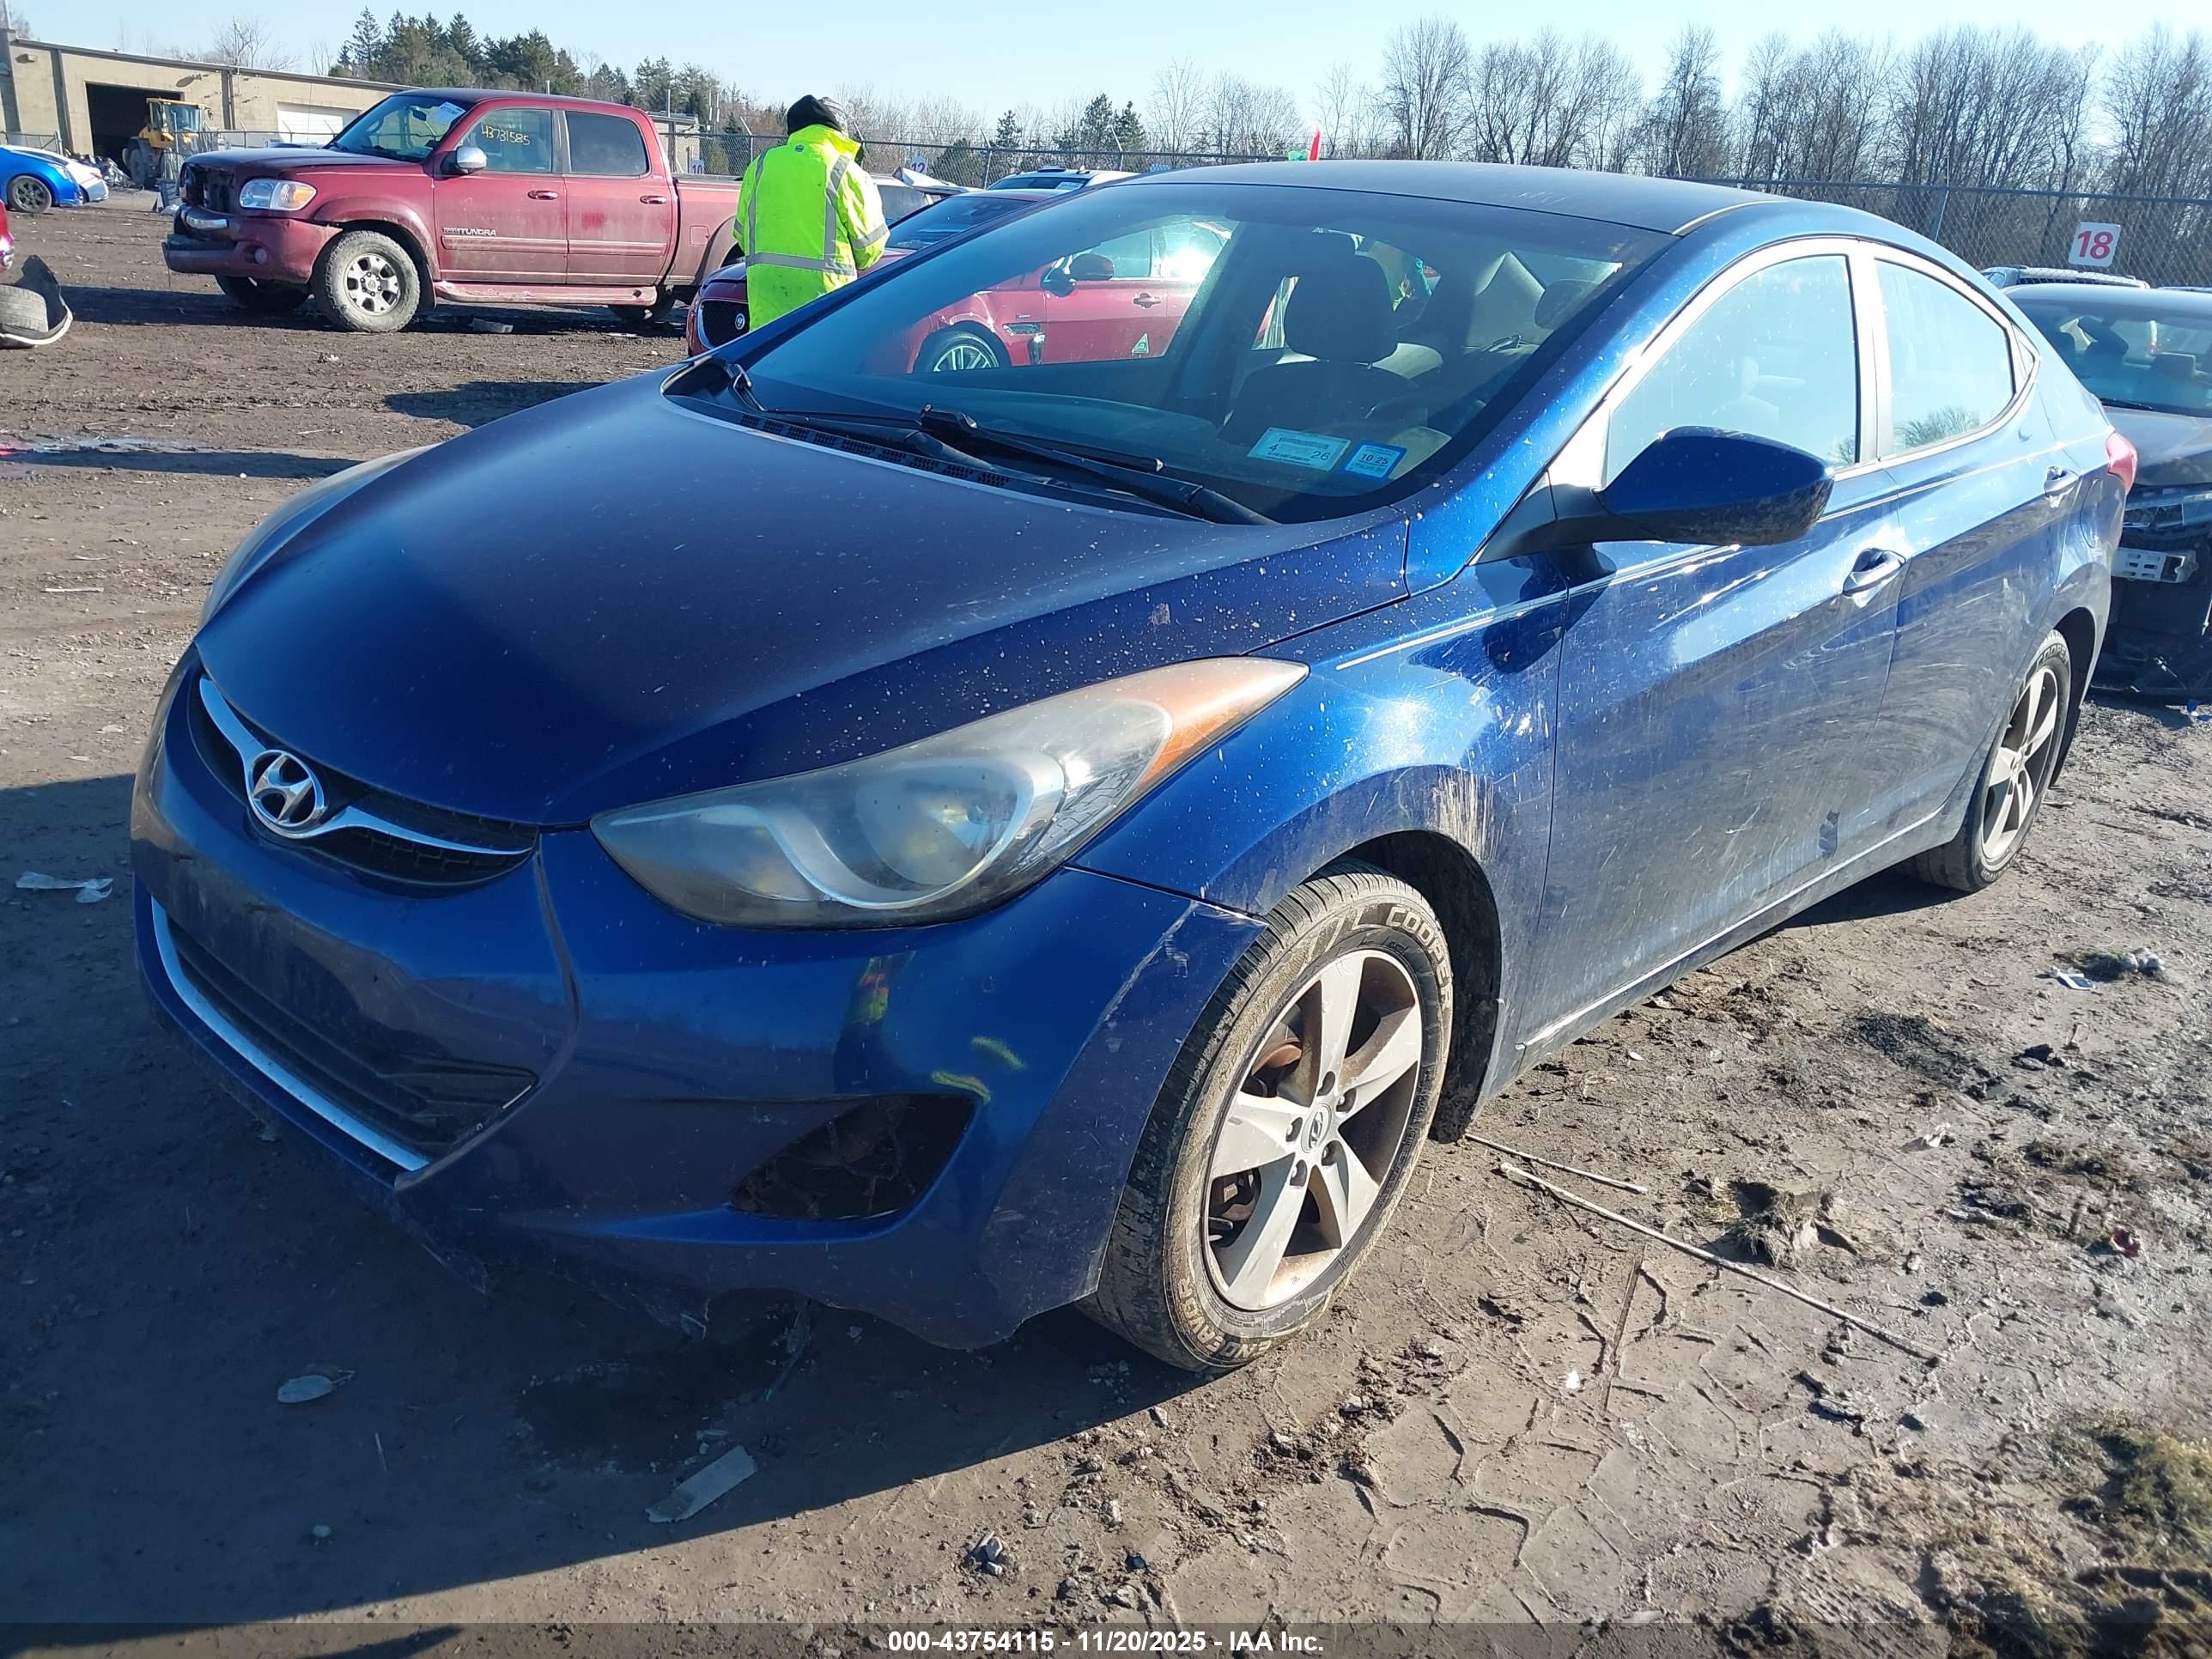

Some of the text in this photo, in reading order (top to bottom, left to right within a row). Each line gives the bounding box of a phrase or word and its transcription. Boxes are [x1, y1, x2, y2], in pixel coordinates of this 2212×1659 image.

[481, 125, 531, 146] 43731585
[460, 228, 497, 236] TUNDRA
[2077, 230, 2114, 259] 18
[1310, 450, 1331, 461] 26
[1385, 903, 1451, 1009] COOPER
